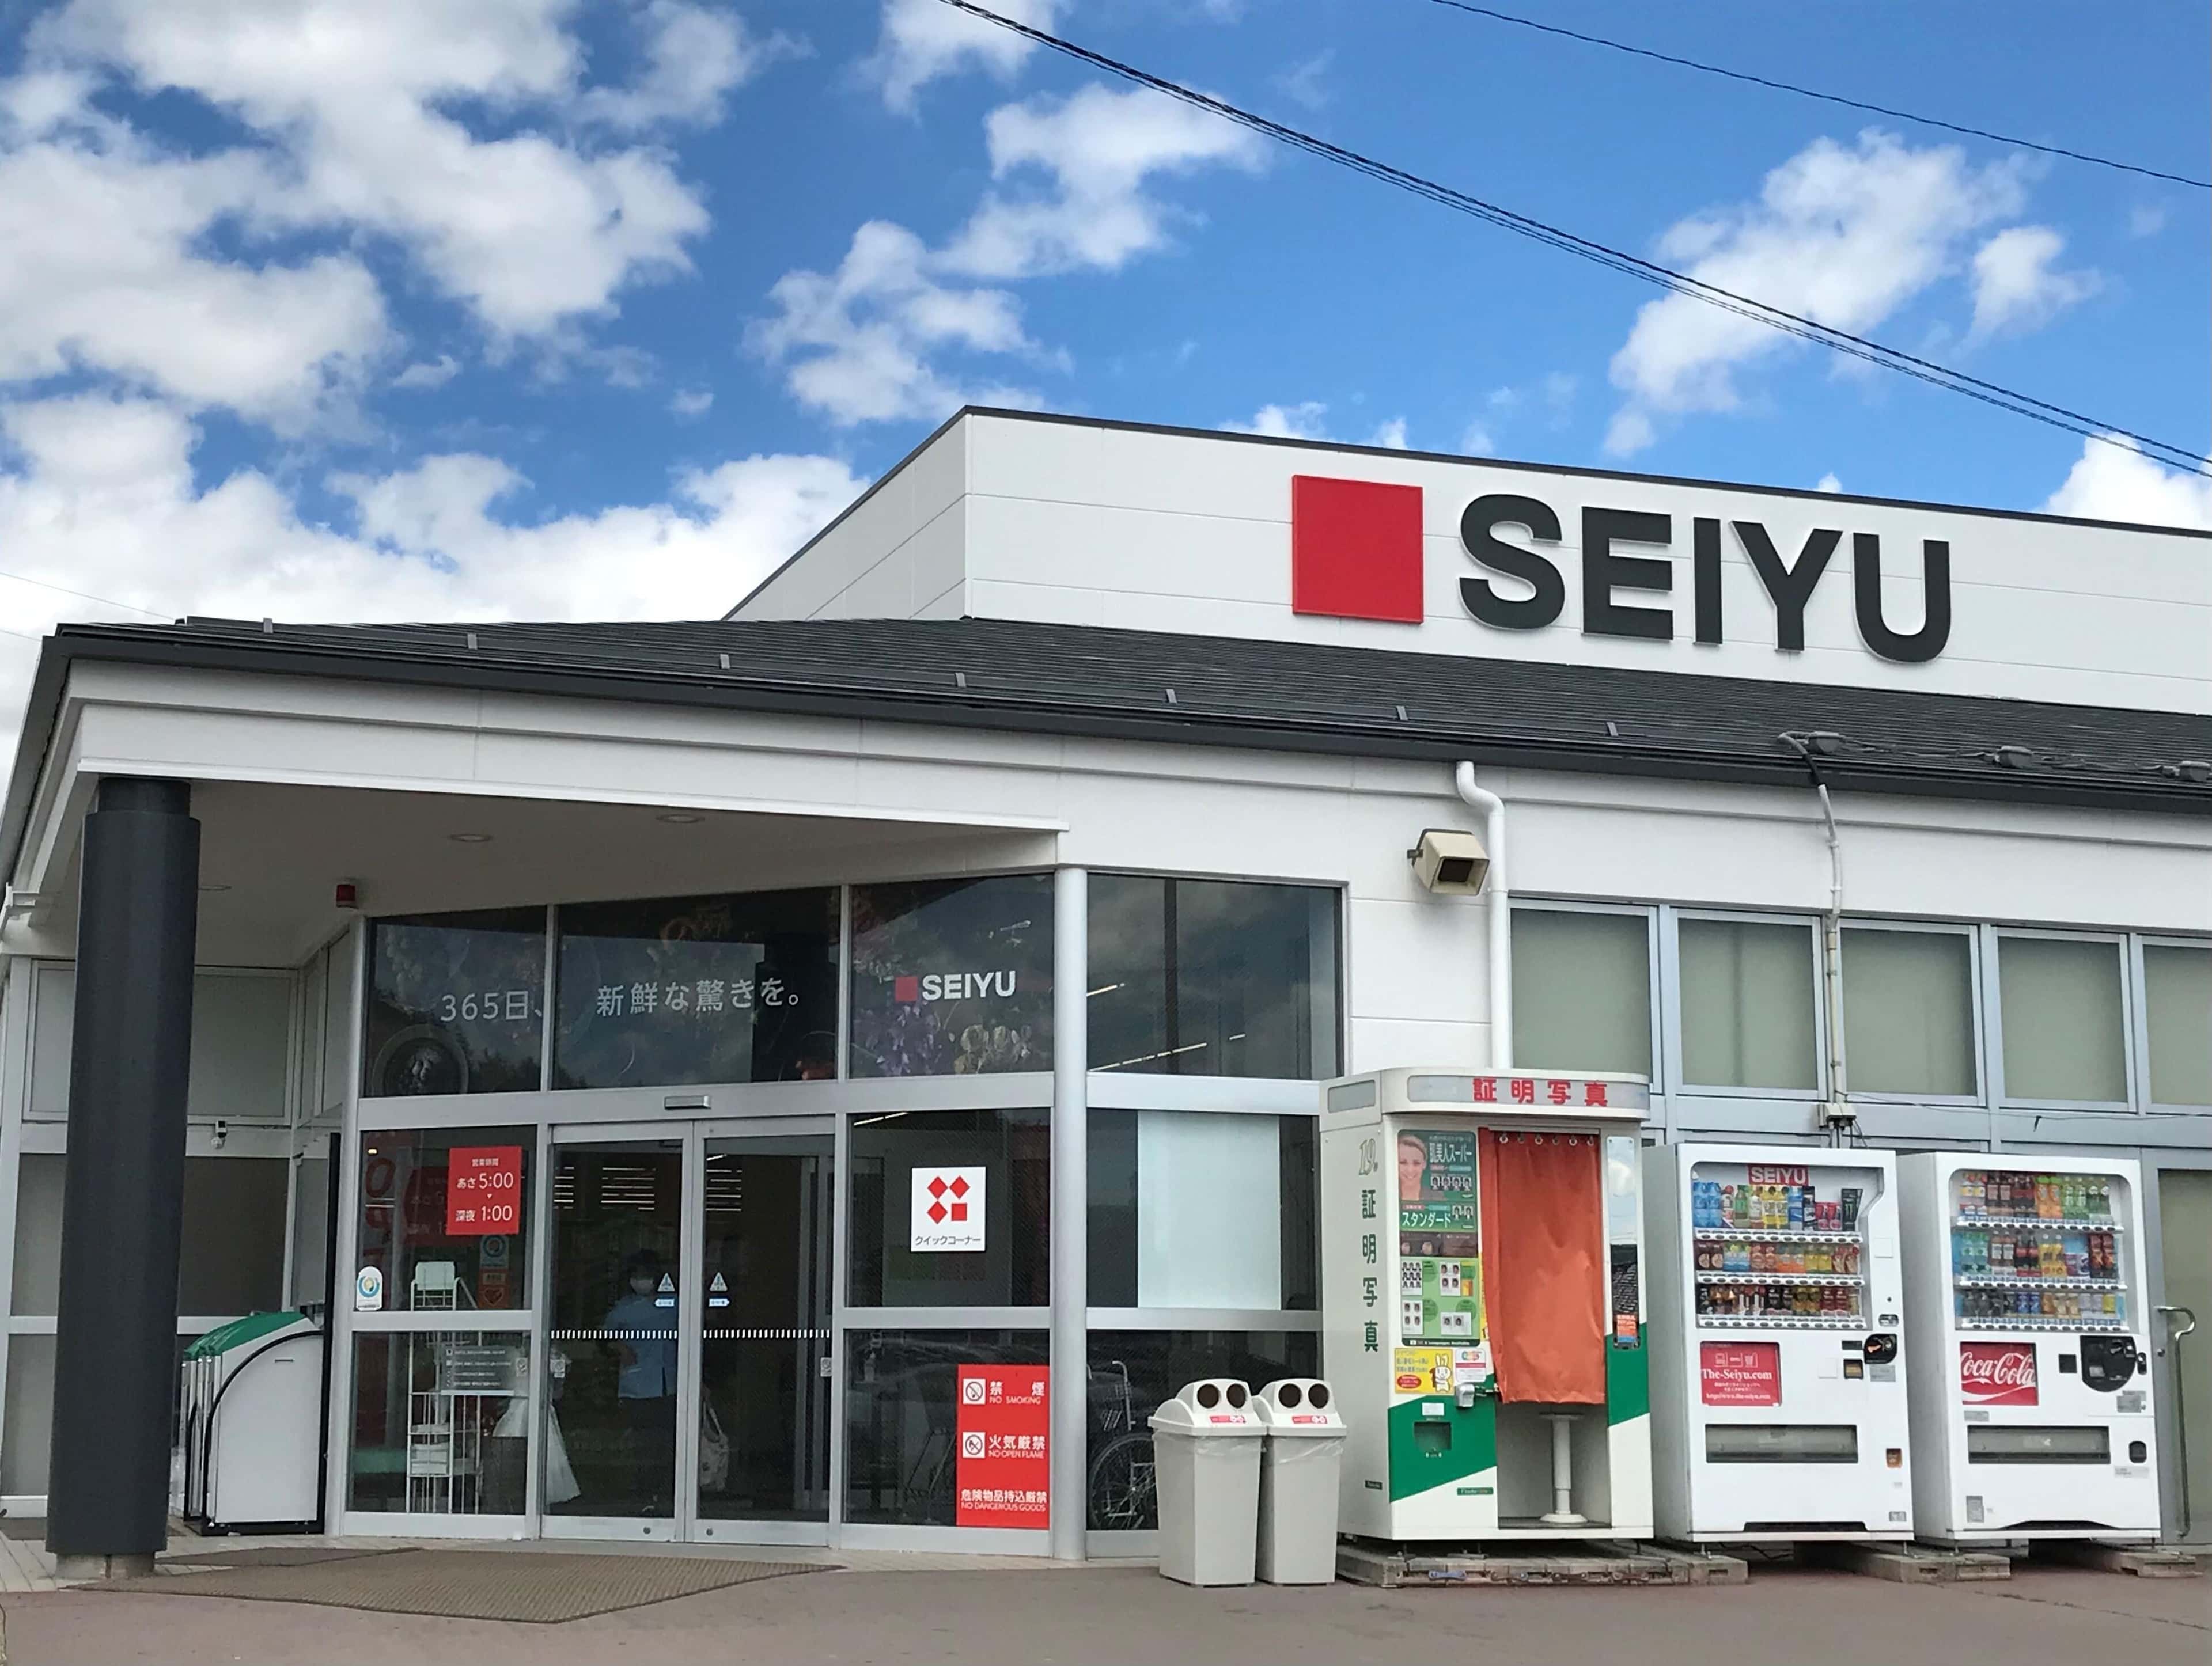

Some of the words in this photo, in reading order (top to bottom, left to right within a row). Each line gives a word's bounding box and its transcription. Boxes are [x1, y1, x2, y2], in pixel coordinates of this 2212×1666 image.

[1459, 494, 1951, 663] SEIYU
[922, 971, 1016, 1001] SEIYU
[596, 977, 799, 1017] 新鮮な驚きを。
[1472, 1077, 1608, 1106] 証明写真
[457, 1177, 476, 1189] あさ
[479, 1172, 514, 1189] 5:00
[1751, 1167, 1806, 1185] SEIYU
[482, 1205, 513, 1221] 1:00
[1402, 1212, 1451, 1228] スタンダード
[915, 1235, 981, 1246] クイックコーナー
[1362, 1189, 1378, 1352] 証明写真
[1702, 1368, 1772, 1381] The-Seiyu.com
[989, 1396, 1002, 1404] NO
[988, 1434, 1046, 1451] 火気厳禁
